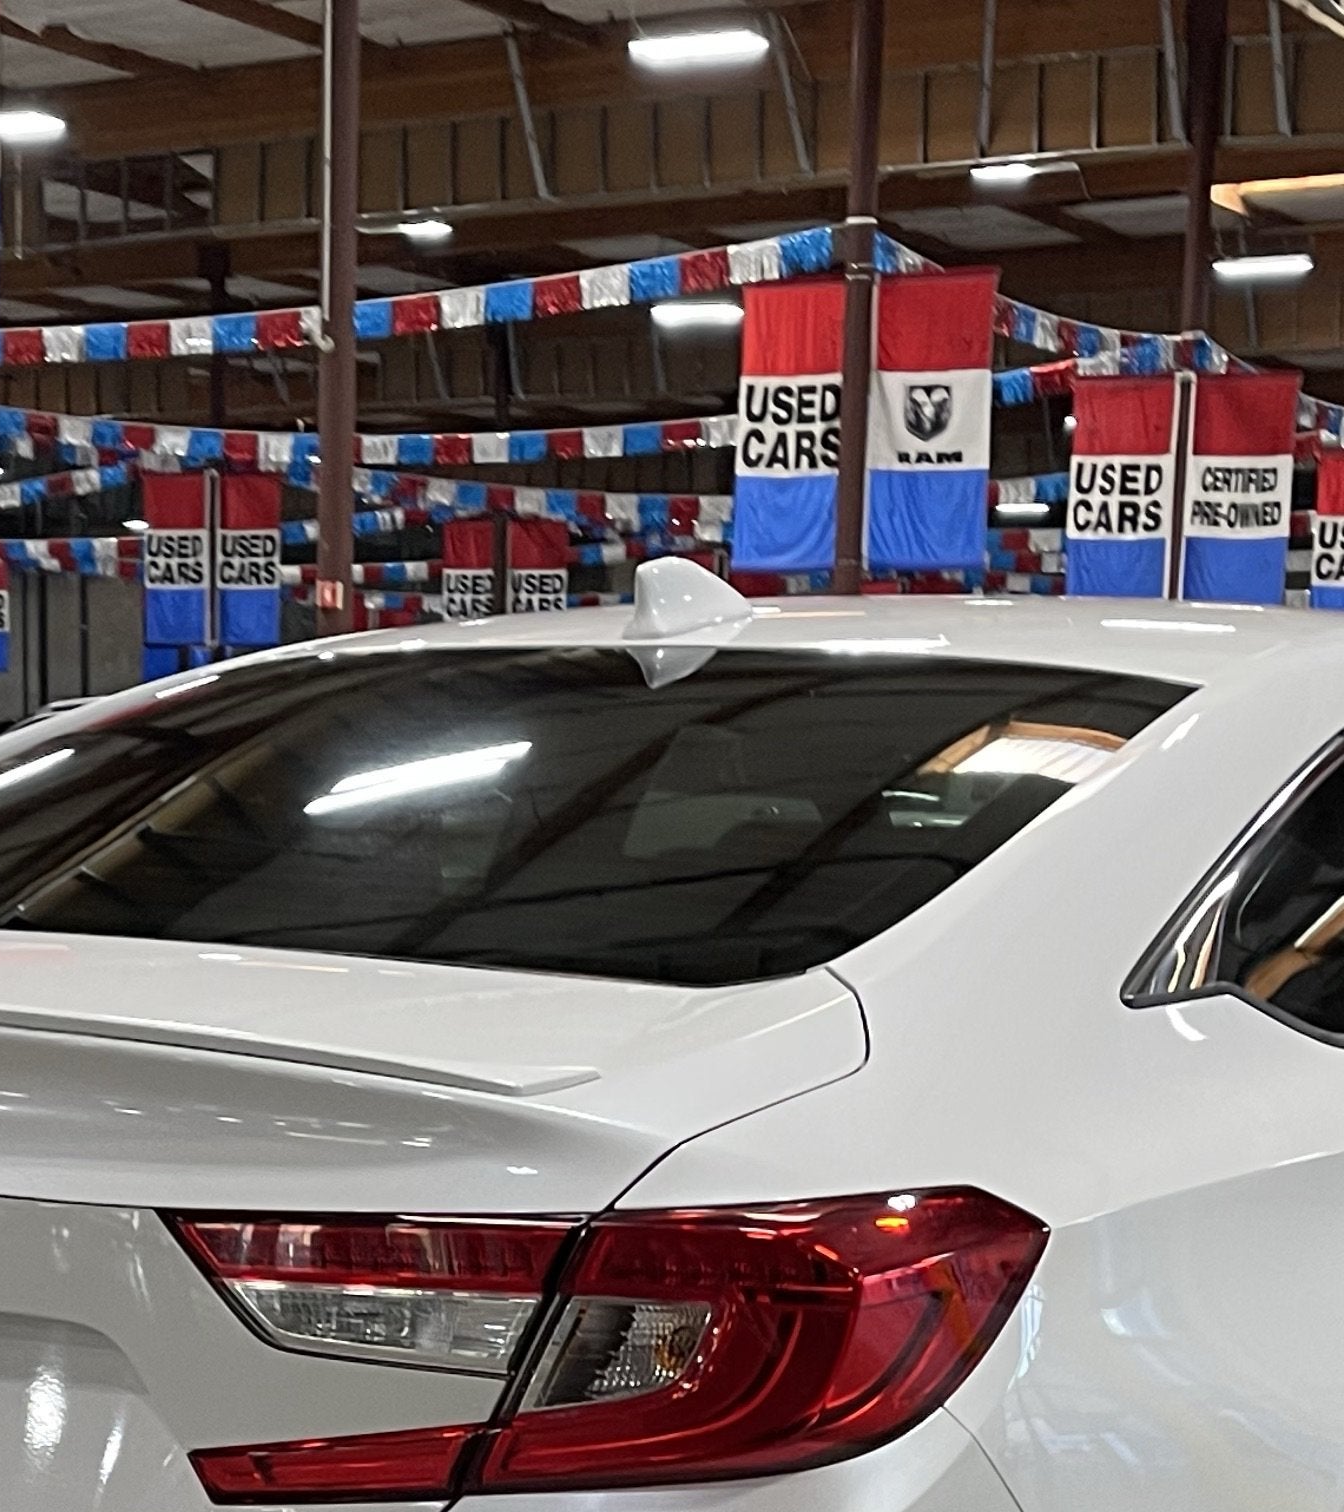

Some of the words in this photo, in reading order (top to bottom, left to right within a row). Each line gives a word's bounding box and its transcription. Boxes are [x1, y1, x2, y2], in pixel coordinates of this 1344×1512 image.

[746, 383, 841, 425] USED
[742, 427, 840, 469] CARS
[897, 451, 963, 463] RAM
[1075, 463, 1163, 495] USED
[1073, 499, 1163, 533] CARS
[147, 535, 203, 558] USED
[220, 534, 277, 558] USED
[146, 561, 204, 584] CARS
[219, 561, 277, 585] CARS
[511, 573, 564, 594] USED
